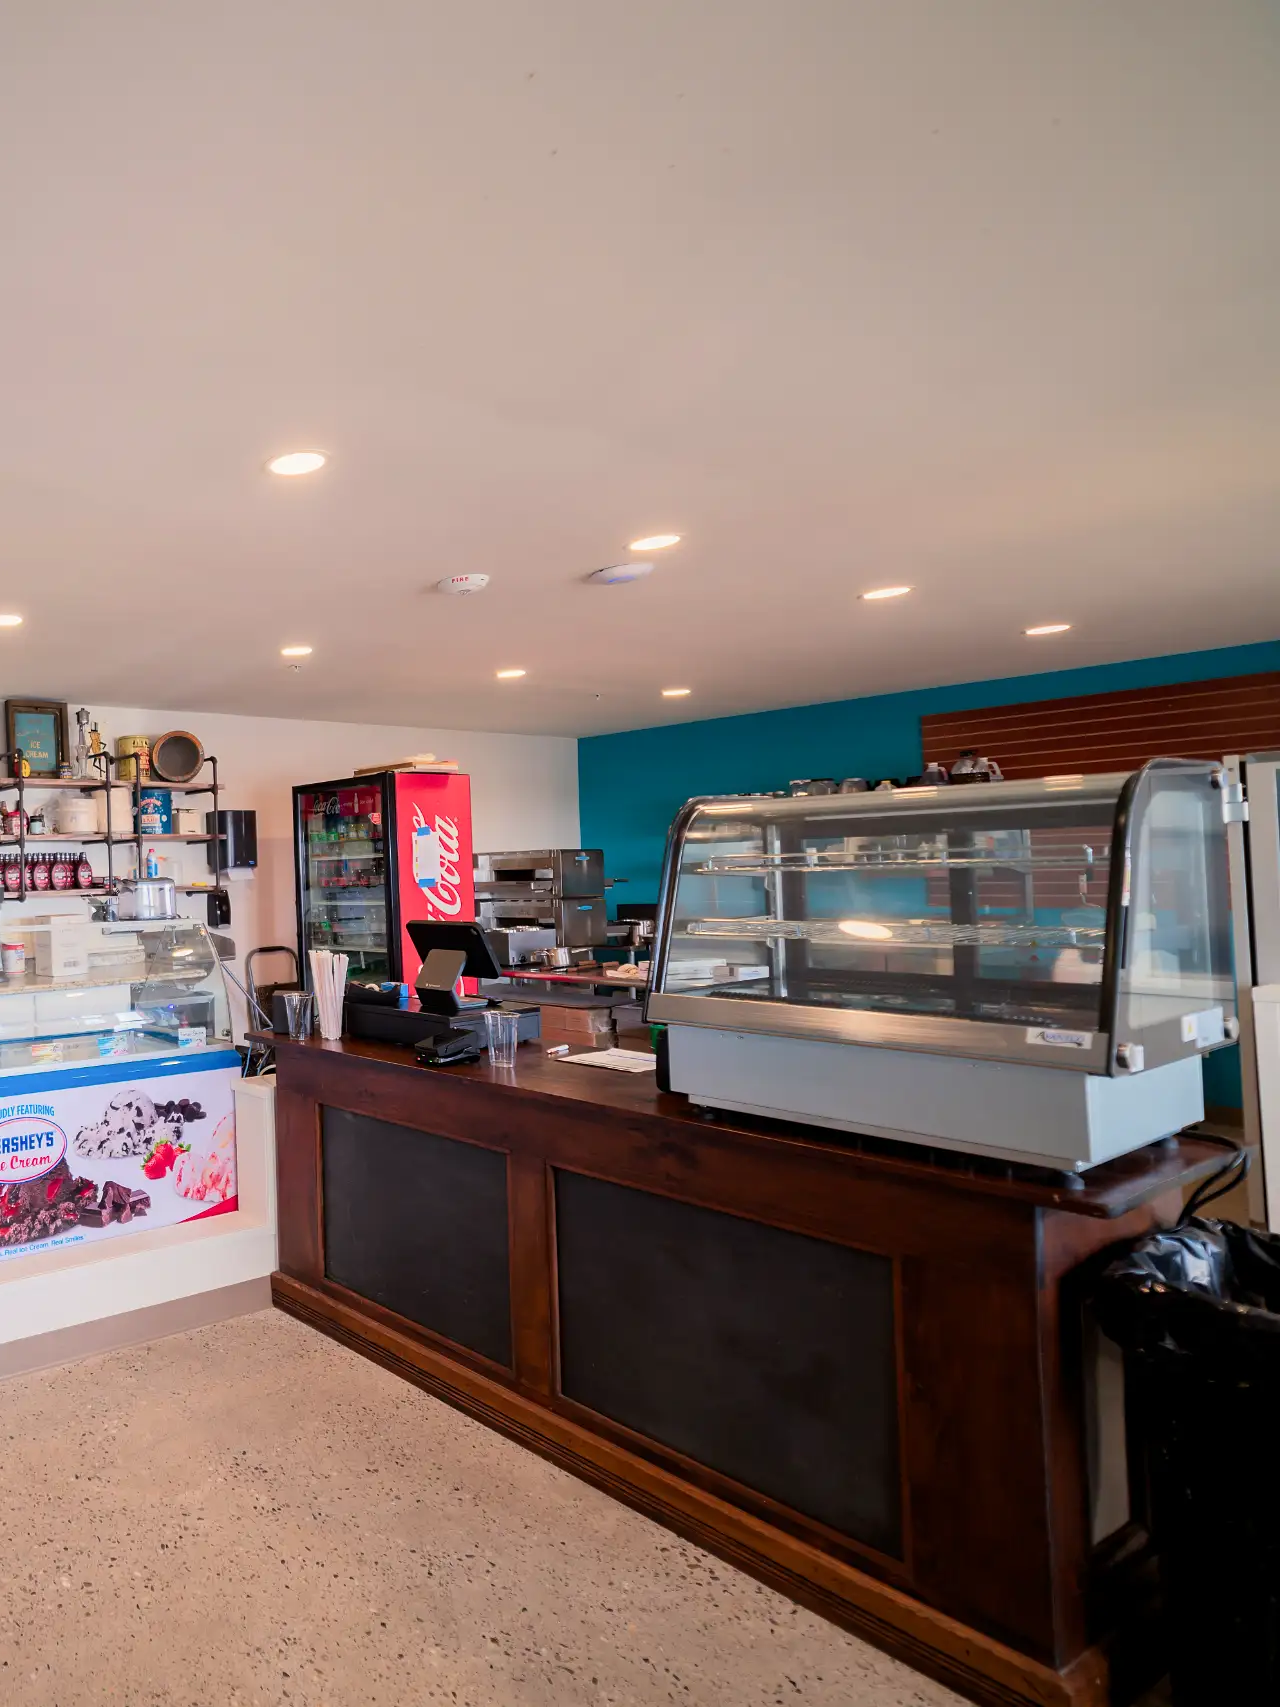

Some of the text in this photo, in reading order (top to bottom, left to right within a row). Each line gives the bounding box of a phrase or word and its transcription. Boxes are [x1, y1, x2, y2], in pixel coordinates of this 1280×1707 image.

[29, 741, 41, 749] ICE
[25, 749, 49, 759] CREAM
[16, 1103, 55, 1117] FEATURING
[10, 1155, 52, 1170] Cream
